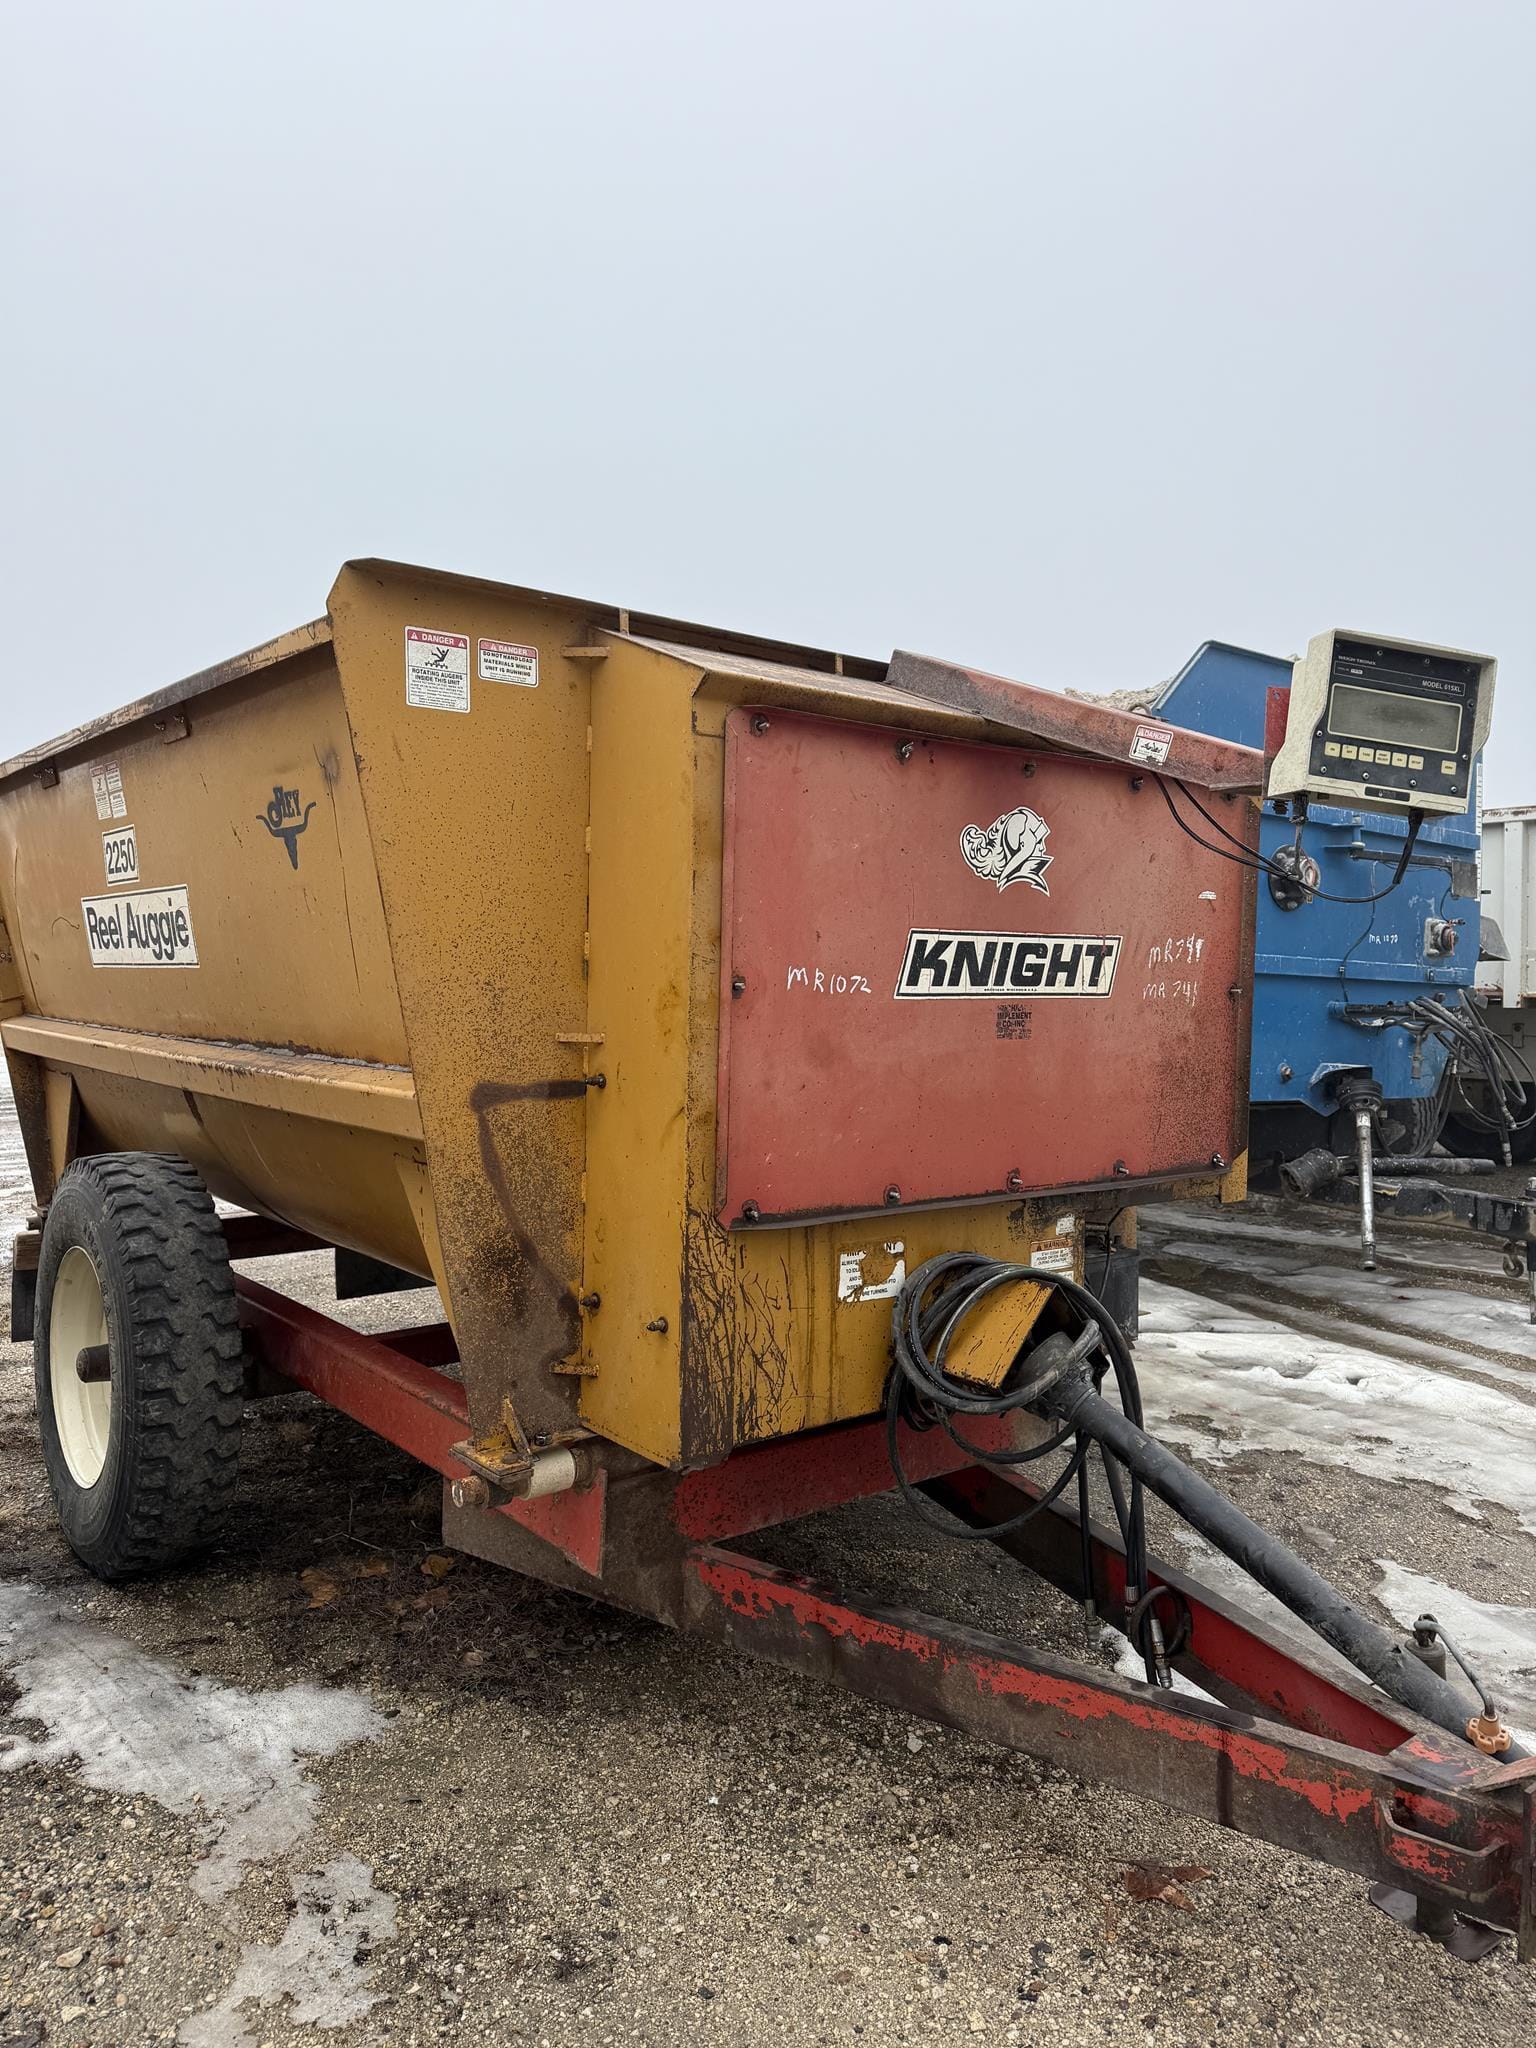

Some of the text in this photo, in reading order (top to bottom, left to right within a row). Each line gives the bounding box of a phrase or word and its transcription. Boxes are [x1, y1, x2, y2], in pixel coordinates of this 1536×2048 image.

[421, 633, 455, 645] DANGER
[498, 645, 528, 656] DANGER
[483, 658, 532, 671] MATERIALS WHILE
[411, 668, 463, 680] ROTATING AUGERS
[414, 674, 434, 682] INSIDE
[506, 668, 531, 677] RUNNING
[1422, 680, 1443, 690] MODEL
[1144, 729, 1170, 742] DANGER
[105, 837, 136, 875] 2250
[85, 897, 190, 961] Reel Auggie
[905, 939, 1114, 988] KNIGHT
[997, 1011, 1032, 1020] IMPLEMENT
